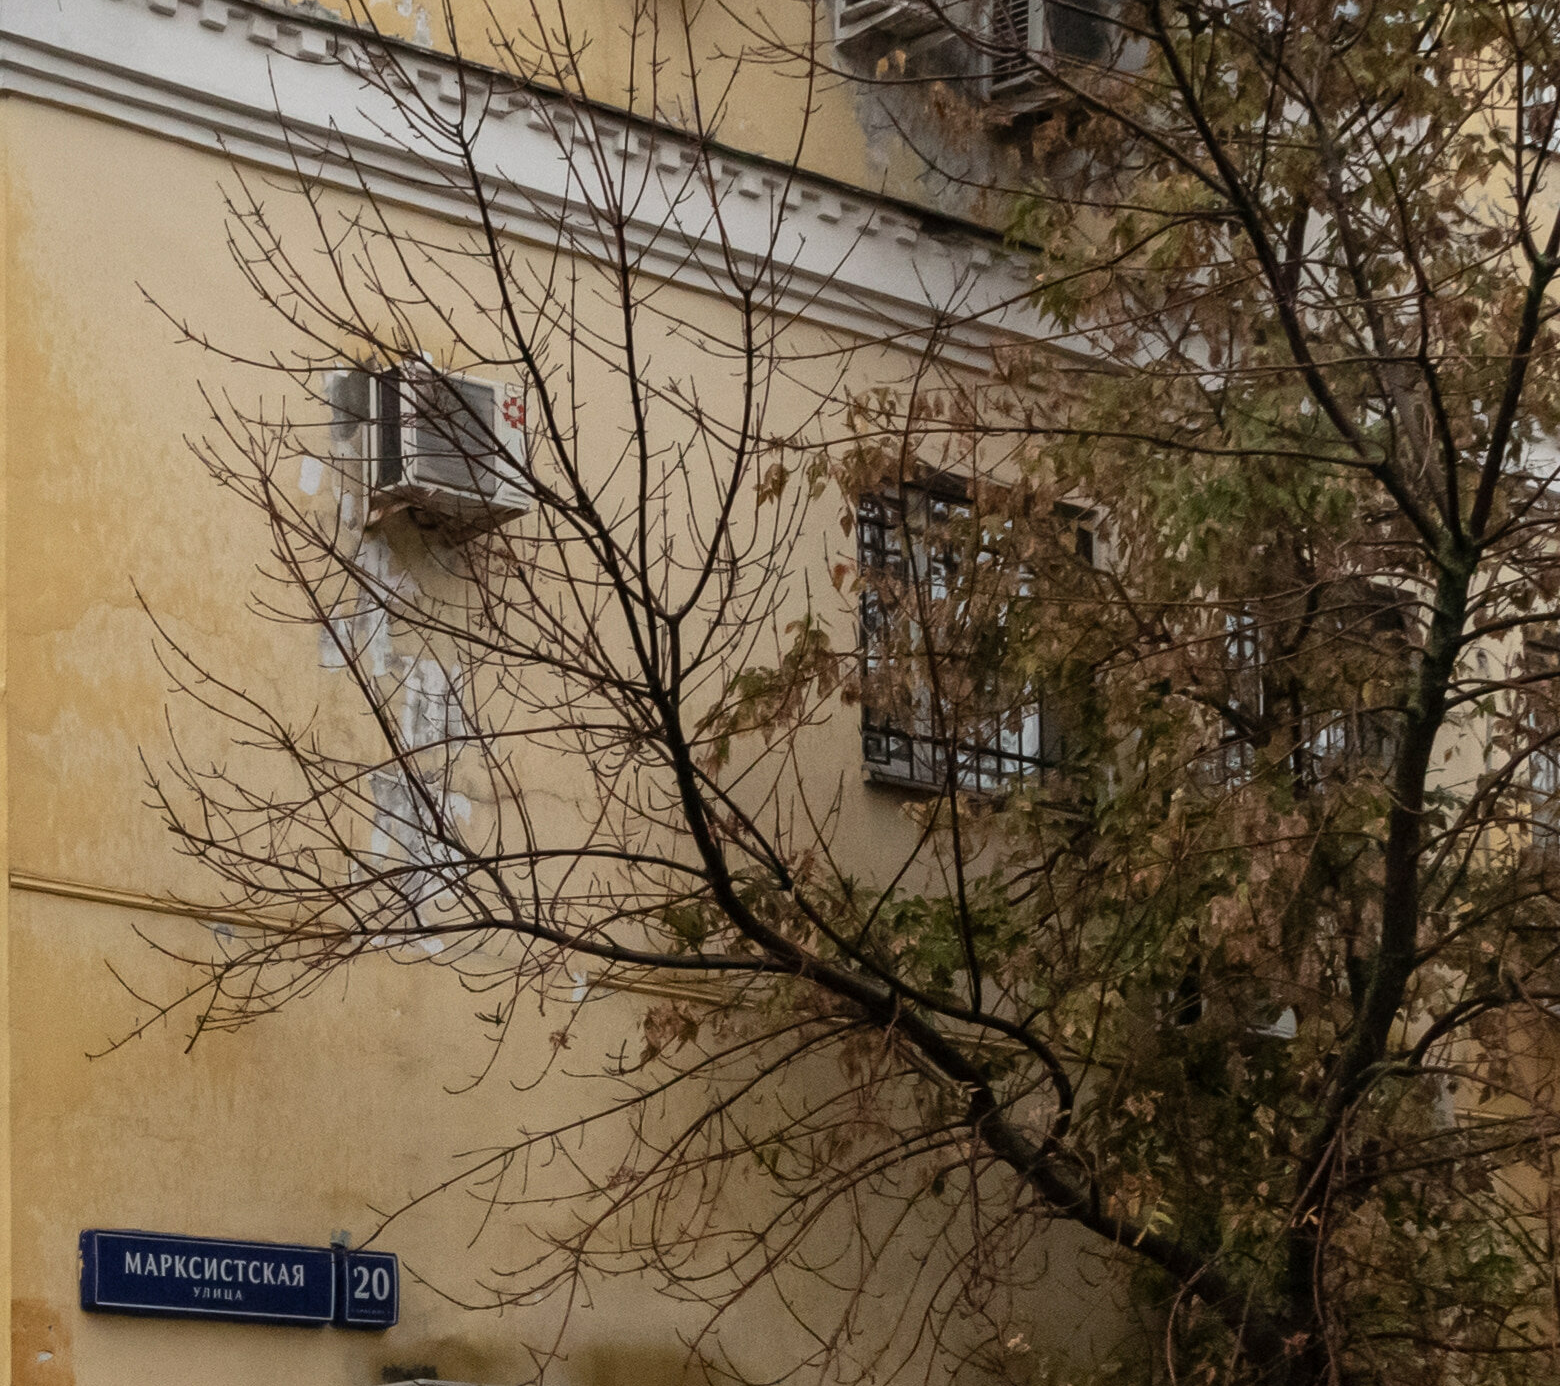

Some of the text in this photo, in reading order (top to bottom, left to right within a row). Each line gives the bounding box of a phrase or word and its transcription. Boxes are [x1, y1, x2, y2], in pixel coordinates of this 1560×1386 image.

[125, 1250, 305, 1287] МАРКСИСТСКАЯ
[353, 1265, 390, 1301] 20
[192, 1286, 244, 1301] УЛИЦА
